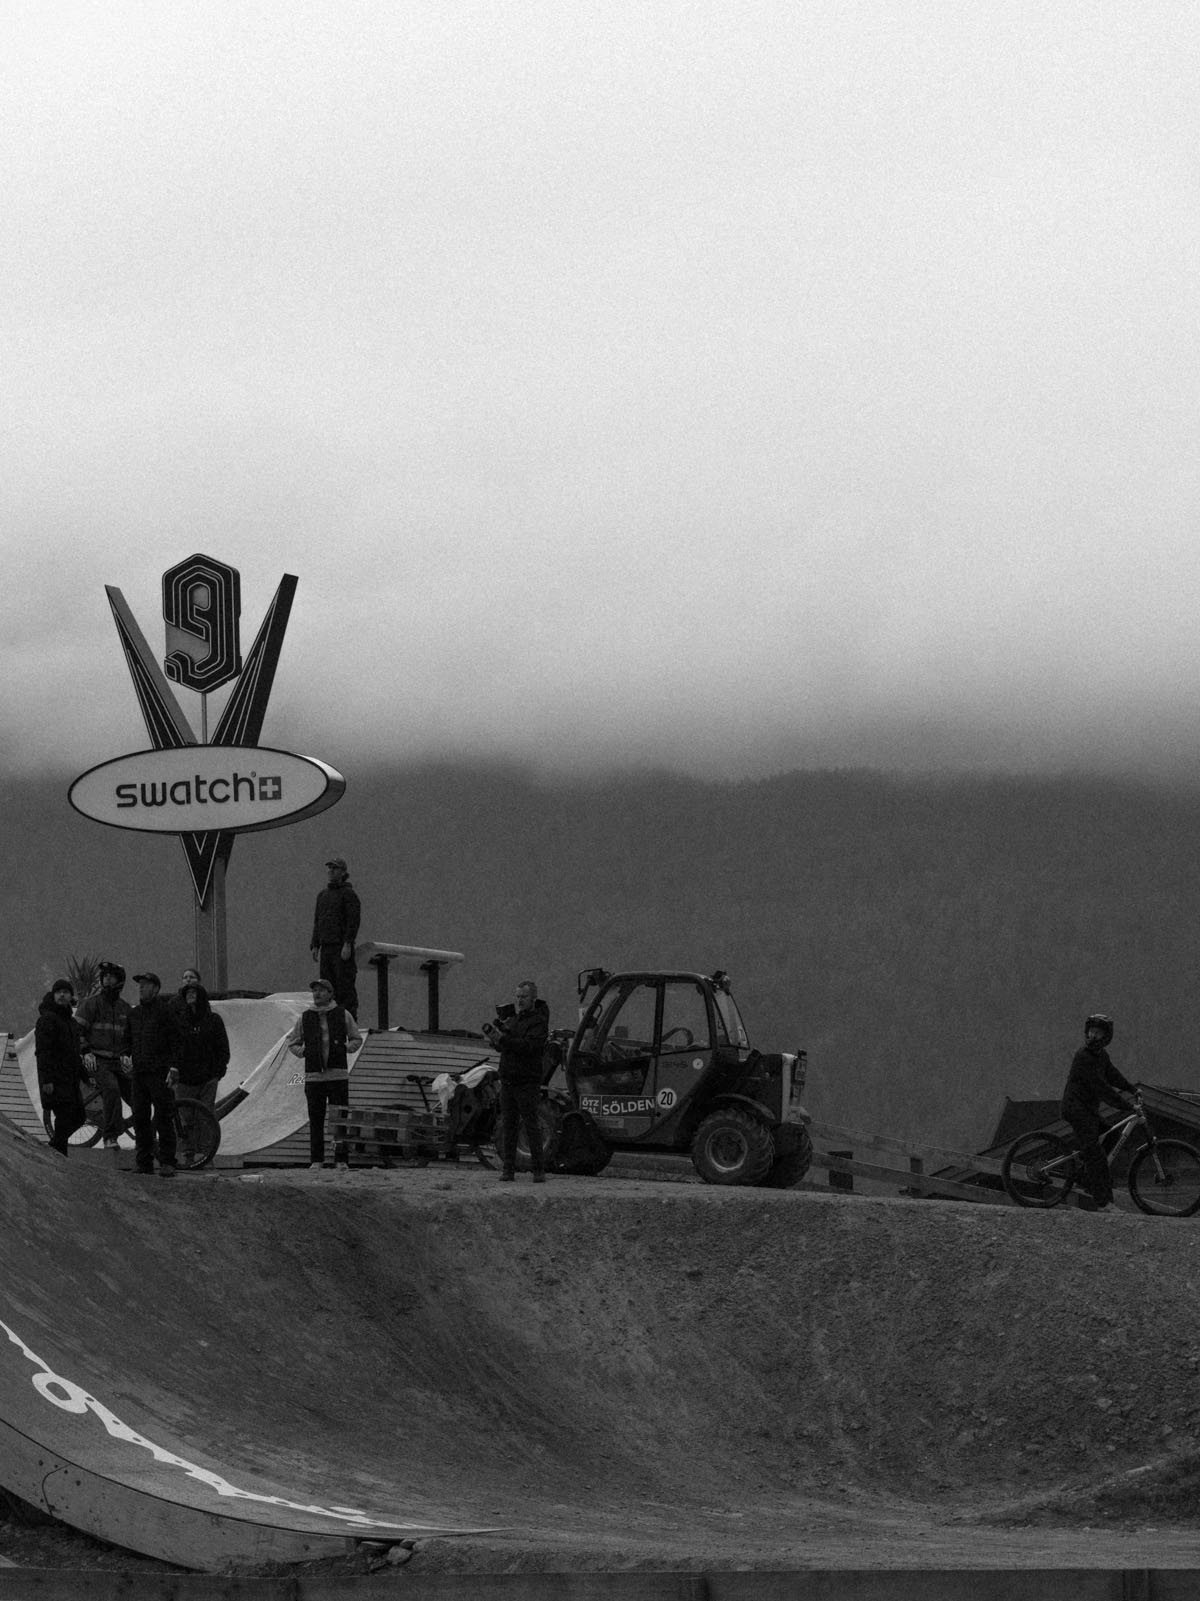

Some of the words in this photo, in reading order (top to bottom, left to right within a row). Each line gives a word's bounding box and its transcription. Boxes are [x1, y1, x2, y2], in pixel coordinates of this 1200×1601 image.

[115, 773, 255, 808] swatch
[582, 1097, 600, 1107] ÖTZ
[660, 1091, 673, 1106] 20
[602, 1099, 655, 1115] SÖLDEN
